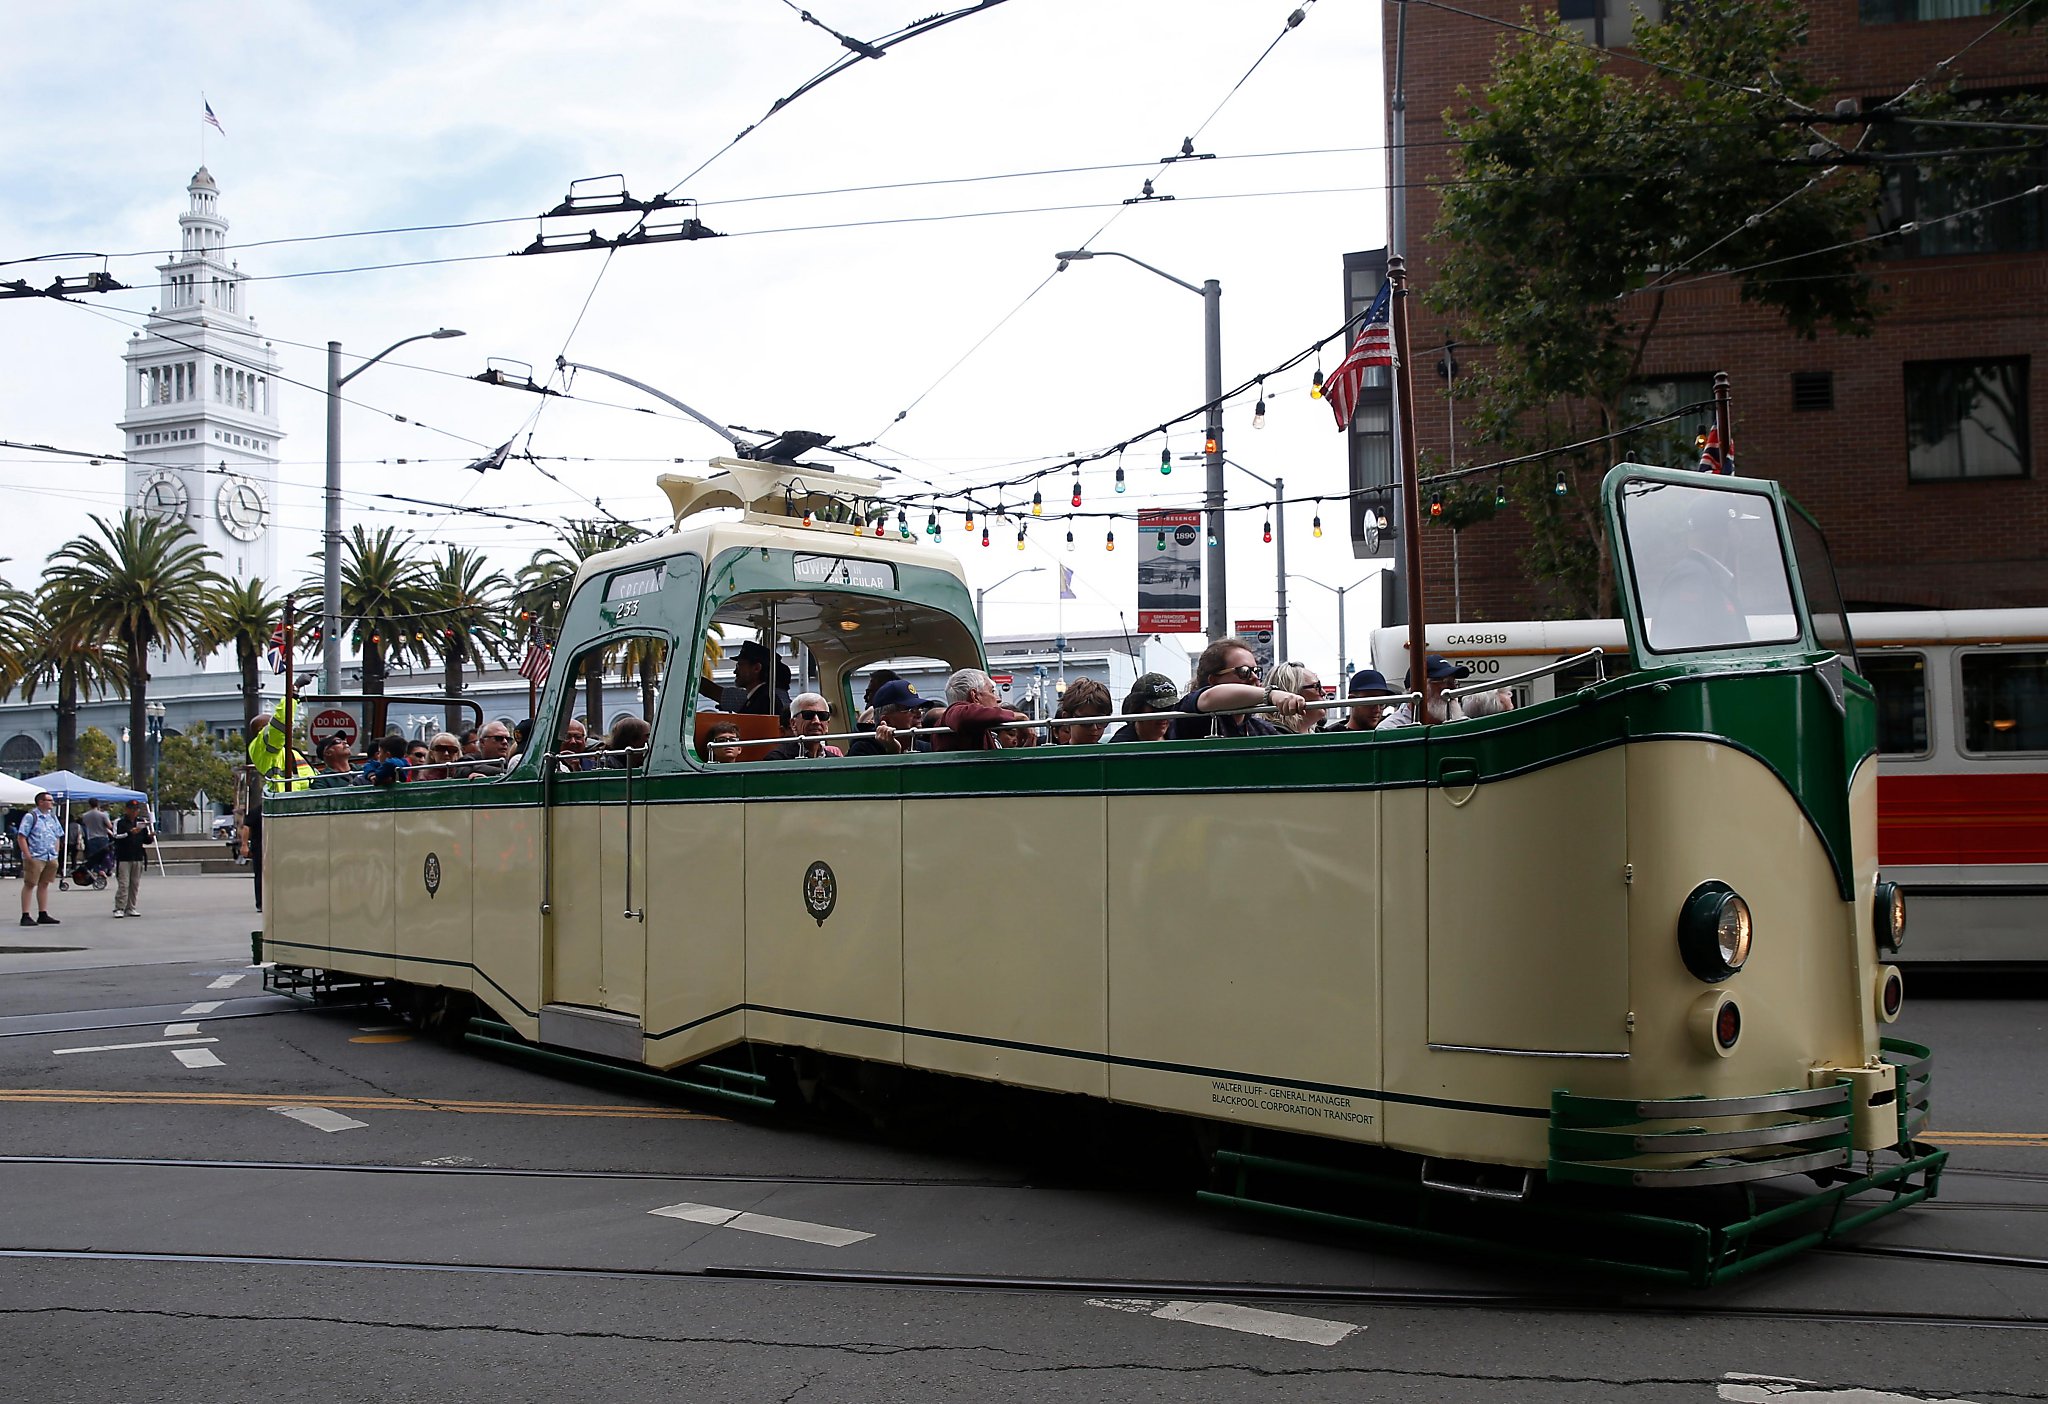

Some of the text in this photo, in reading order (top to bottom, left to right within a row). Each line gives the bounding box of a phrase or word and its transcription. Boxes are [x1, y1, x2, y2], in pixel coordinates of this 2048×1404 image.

[615, 600, 640, 619] 233
[1447, 634, 1507, 644] CA49819
[317, 718, 350, 726] DO NOT
[1212, 1081, 1242, 1093] WALTER
[1245, 1085, 1262, 1095] LUFF
[1270, 1088, 1306, 1102] GENERAL
[1309, 1094, 1351, 1107] MANAGER
[1212, 1094, 1375, 1125] BLACKPOOL CORPORATION TRANSPORT
